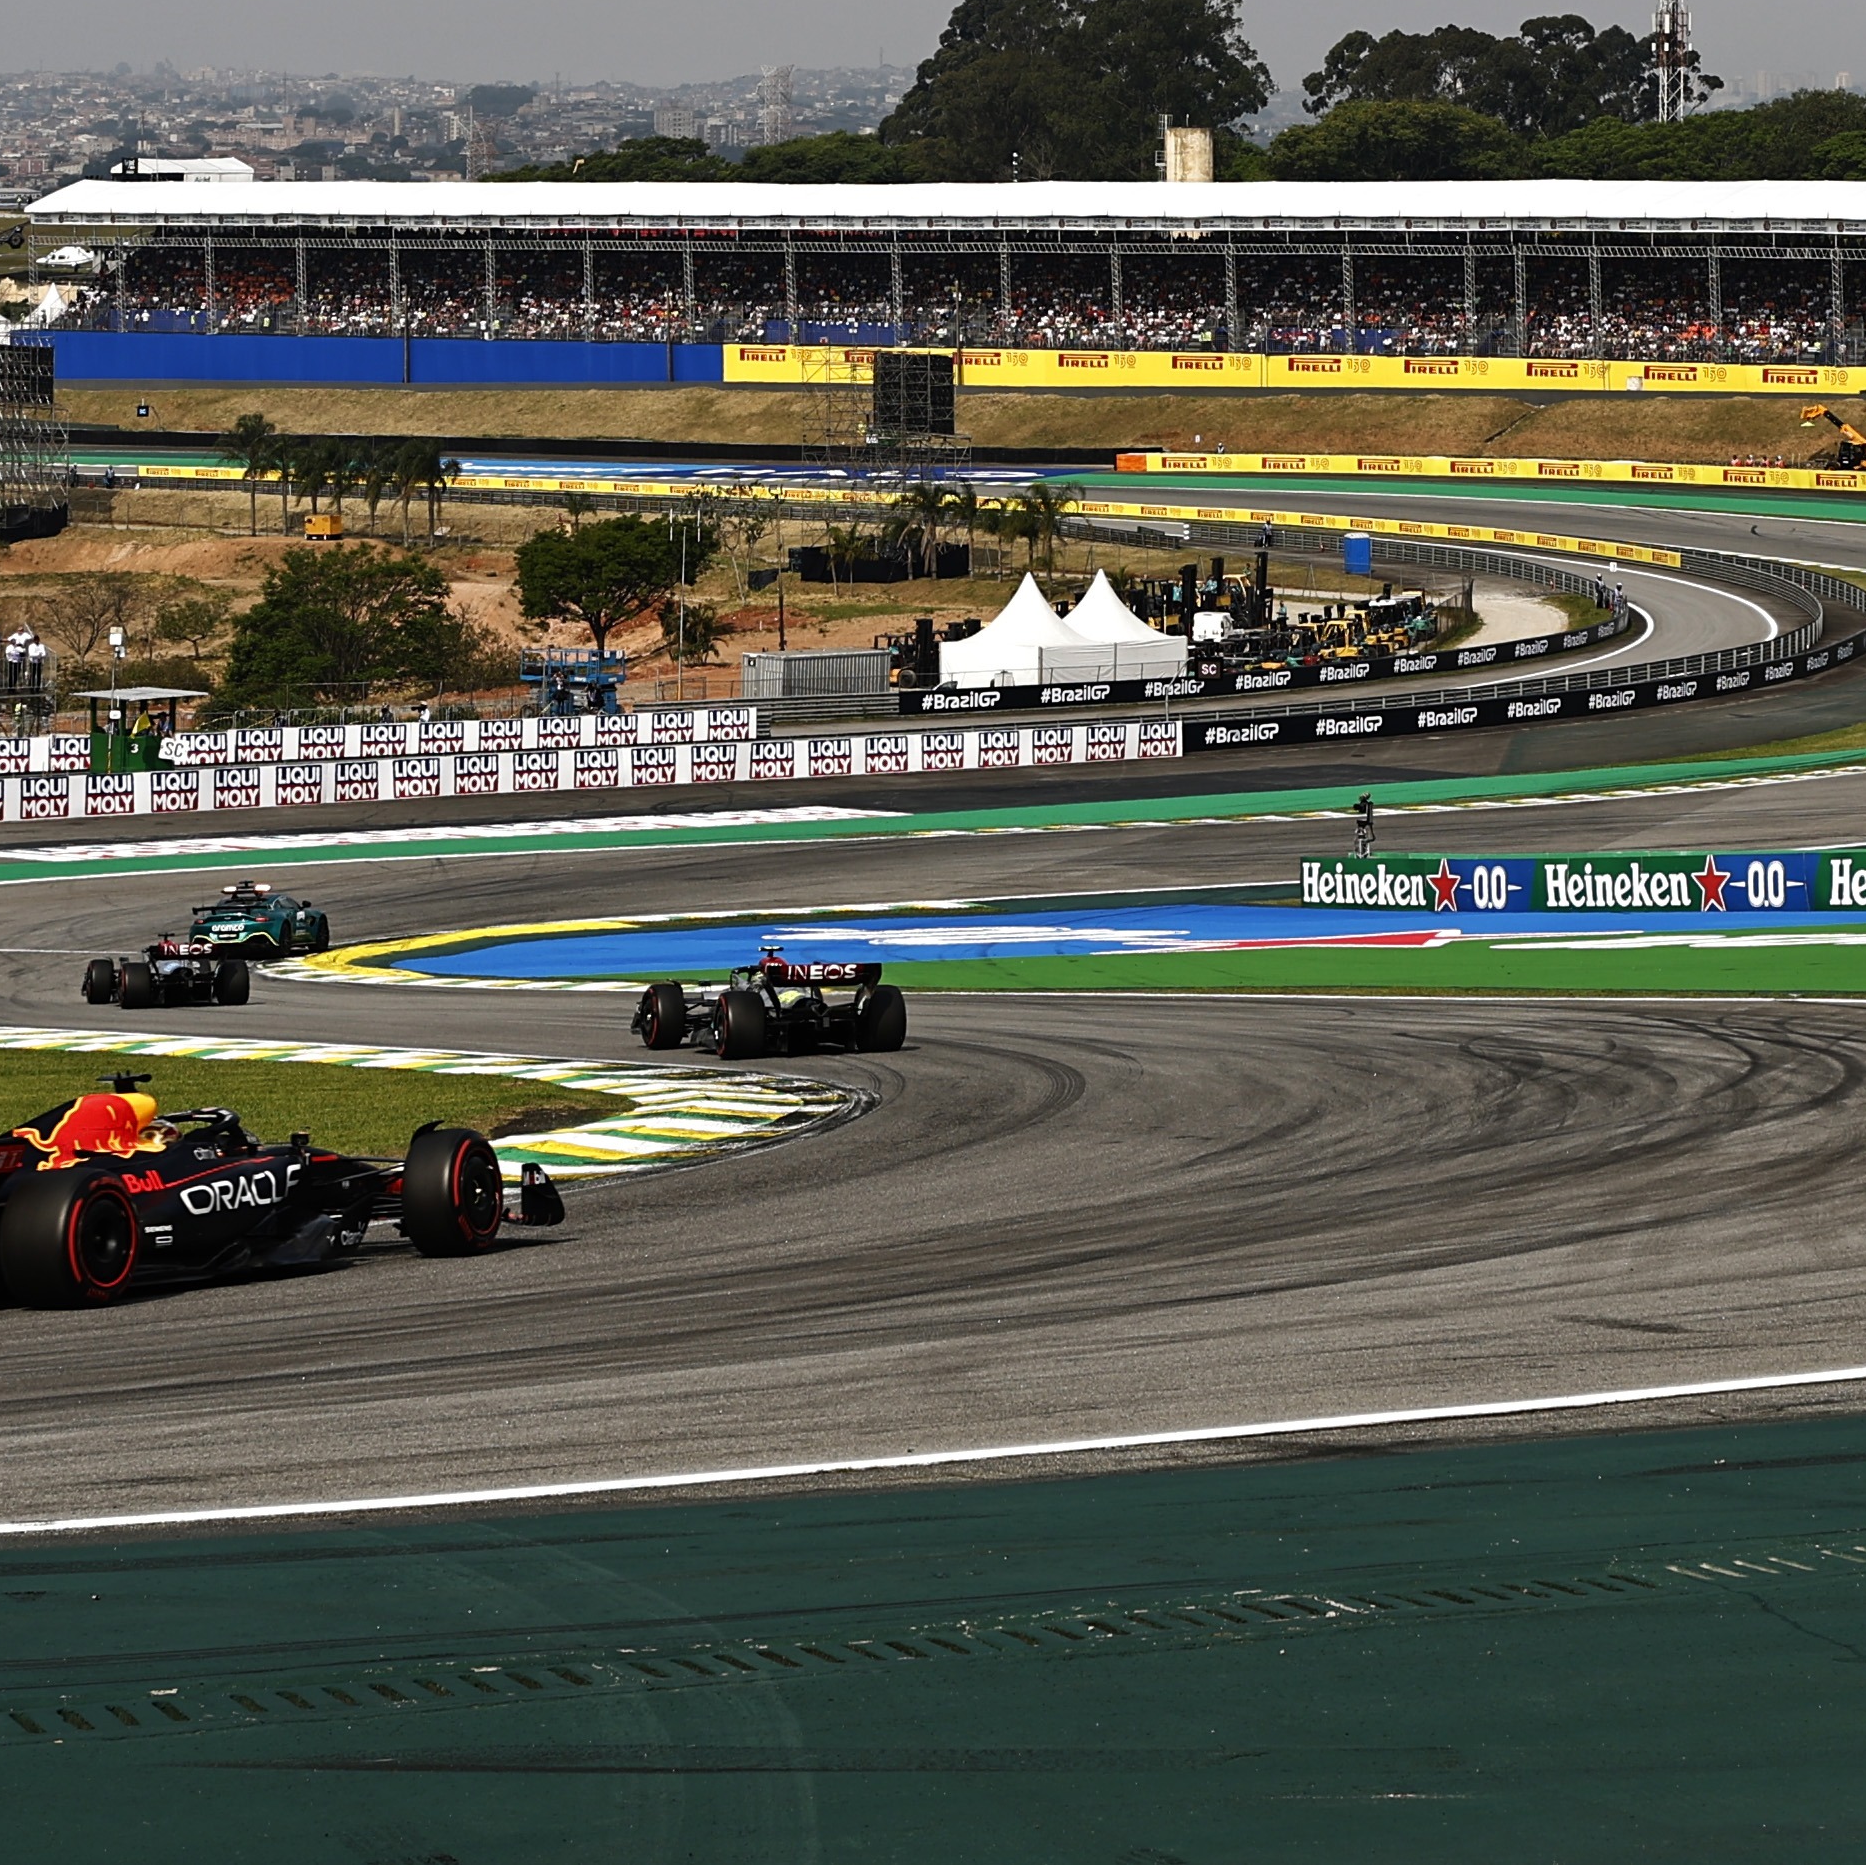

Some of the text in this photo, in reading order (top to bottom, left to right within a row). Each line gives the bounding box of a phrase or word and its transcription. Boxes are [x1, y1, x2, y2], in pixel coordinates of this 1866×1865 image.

[739, 348, 786, 362] PIRELLI
[1058, 353, 1109, 368] PIRELLI
[1172, 355, 1223, 370] PIRELLI
[1288, 357, 1341, 373] PIRELLI
[1404, 359, 1458, 375] PIRELLI
[1526, 362, 1578, 377] PIRELLI
[1644, 365, 1697, 381] PIRELLI
[1762, 368, 1818, 384] PIRELLI
[1161, 457, 1207, 469] PIRELLI
[1261, 457, 1305, 470] PIRELLI
[1357, 459, 1400, 471] PIRELLI
[1450, 461, 1494, 474] PIRELLI
[1539, 463, 1580, 476] PIRELLI
[1632, 465, 1673, 480] PIRELLI
[1723, 469, 1766, 484] PIRELLI
[1816, 473, 1857, 488] PIRELLI
[1393, 655, 1437, 673] #BrazilGP
[1457, 648, 1497, 666] #BrazilGP
[1201, 663, 1218, 675] SC
[1319, 663, 1370, 682] #BrazilGP
[1144, 680, 1205, 697] #BrazilGP
[1235, 671, 1291, 690] #BrazilGP
[1041, 685, 1111, 704] #BrazilGP
[1657, 682, 1697, 700] #BrazilGP
[922, 691, 1001, 711] #BrazilGP
[1507, 699, 1561, 718] #BrazilGP
[1588, 691, 1635, 709] #BrazilGP
[1316, 715, 1383, 735] #BrazilGP
[1417, 707, 1478, 728] #BrazilGP
[1034, 730, 1071, 745] LIQUI
[1089, 727, 1124, 743] LIQUI
[1141, 723, 1175, 739] LIQUI
[1204, 722, 1280, 744] #BrazilGP
[130, 743, 139, 754] 3
[164, 741, 184, 758] SC
[867, 737, 906, 754] LIQUI
[924, 733, 962, 751] LIQUI
[1139, 741, 1175, 758] MOLY
[577, 751, 616, 768] LIQUI
[693, 746, 734, 763] LIQUI
[753, 743, 792, 759] LIQUI
[1034, 747, 1071, 763] MOLY
[1088, 744, 1124, 759] MOLY
[395, 759, 438, 777] LIQUI
[515, 751, 556, 771] LIQUI
[867, 755, 907, 771] MOLY
[924, 752, 963, 768] MOLY
[337, 763, 376, 781] LIQUI
[693, 764, 735, 781] MOLY
[752, 761, 793, 777] MOLY
[88, 775, 131, 793] LIQUI
[153, 773, 197, 791] LIQUI
[515, 772, 557, 789] MOLY
[576, 769, 617, 787] MOLY
[337, 782, 377, 800] MOLY
[395, 779, 439, 797] MOLY
[87, 795, 133, 813] MOLY
[153, 792, 197, 812] MOLY
[1302, 861, 1508, 910] Heineken 0.0
[1545, 860, 1785, 908] Heineken 0.0
[211, 923, 245, 933] aramco
[163, 943, 213, 957] INEOS
[787, 963, 857, 980] INEOS
[121, 1169, 166, 1195] Bull
